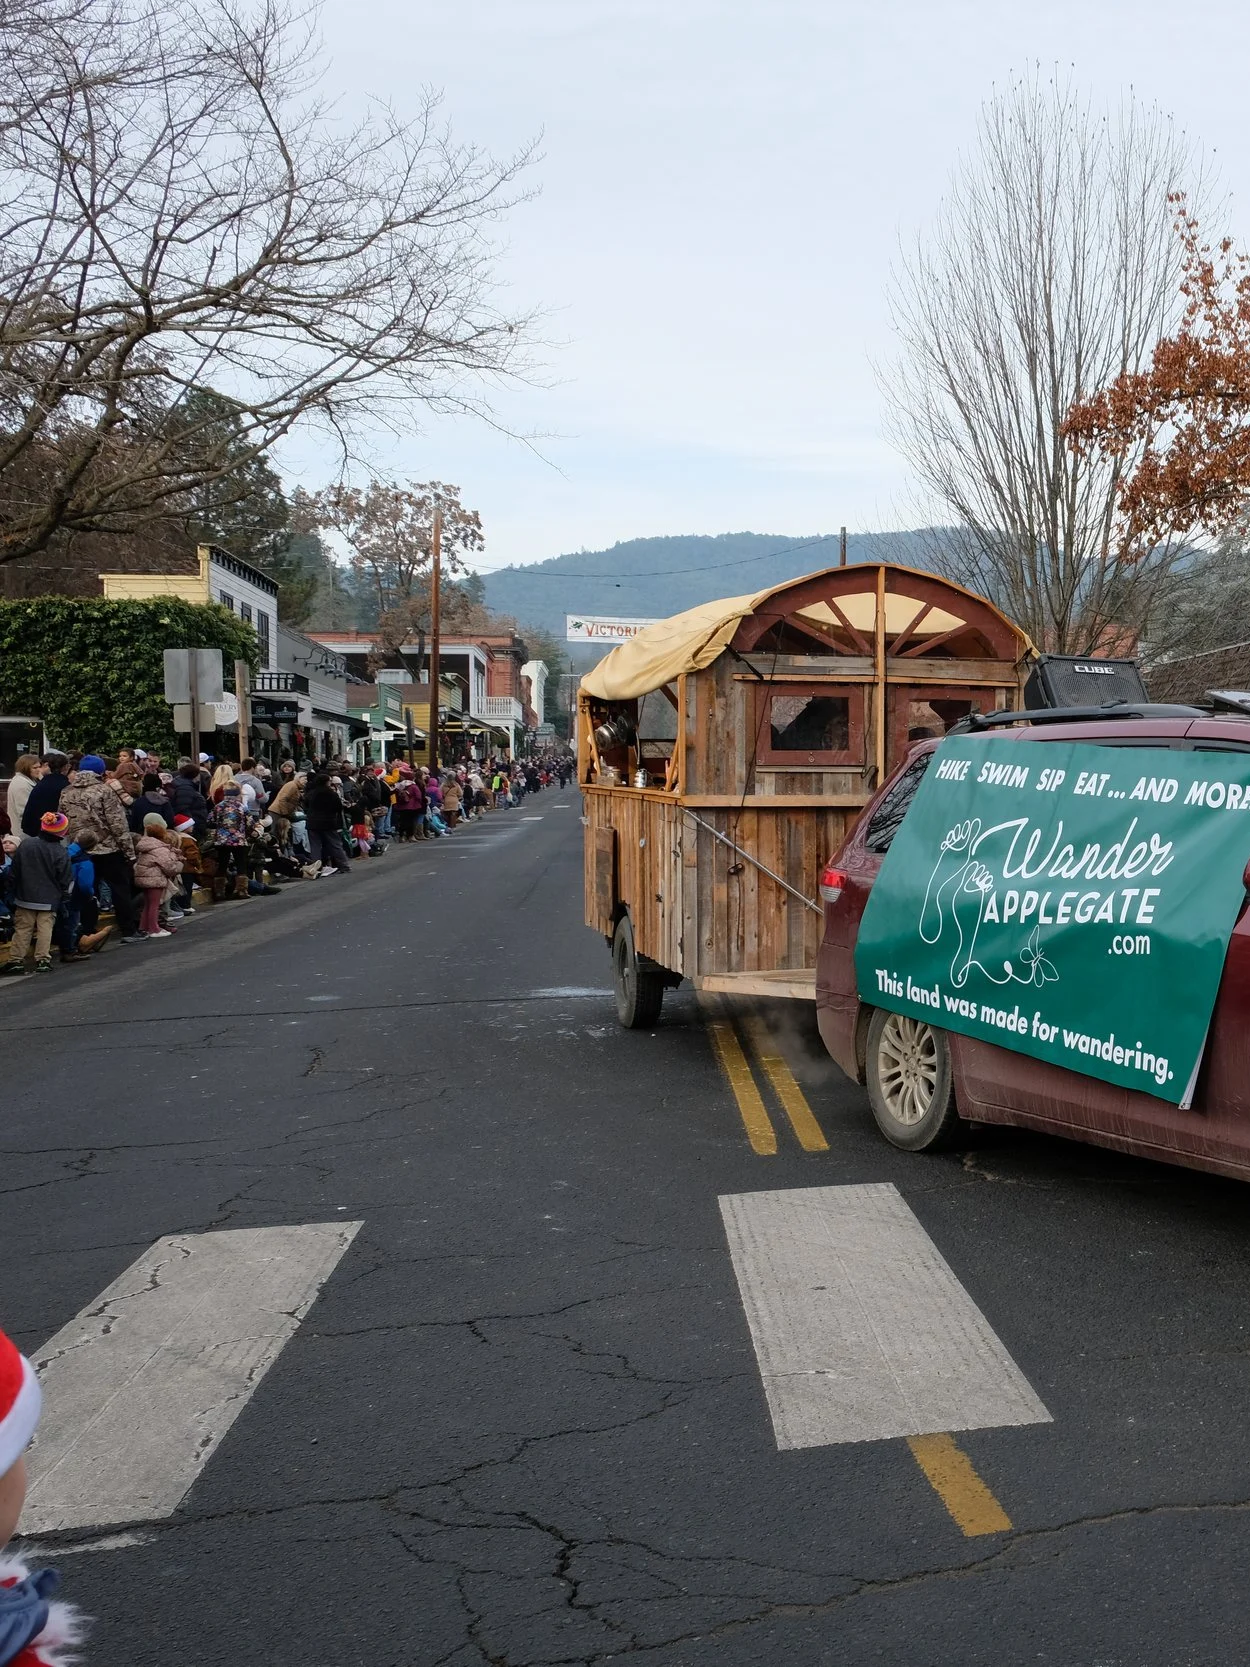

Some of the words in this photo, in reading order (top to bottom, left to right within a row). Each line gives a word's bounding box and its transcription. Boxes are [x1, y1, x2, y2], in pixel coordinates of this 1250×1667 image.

[582, 623, 643, 637] VICTORI
[1074, 665, 1115, 675] CUBE
[935, 759, 972, 781] HIKE
[977, 761, 1030, 788] SWIM
[1035, 768, 1066, 792] SIP
[971, 816, 1175, 880] Wander
[982, 888, 1161, 924] APPLEGATE
[1107, 934, 1151, 955] .com
[875, 968, 904, 998] This
[906, 975, 940, 1008] land
[943, 994, 978, 1019] was
[980, 1005, 1028, 1034] made
[1032, 1011, 1060, 1043] for
[1063, 1033, 1174, 1085] wandering.
